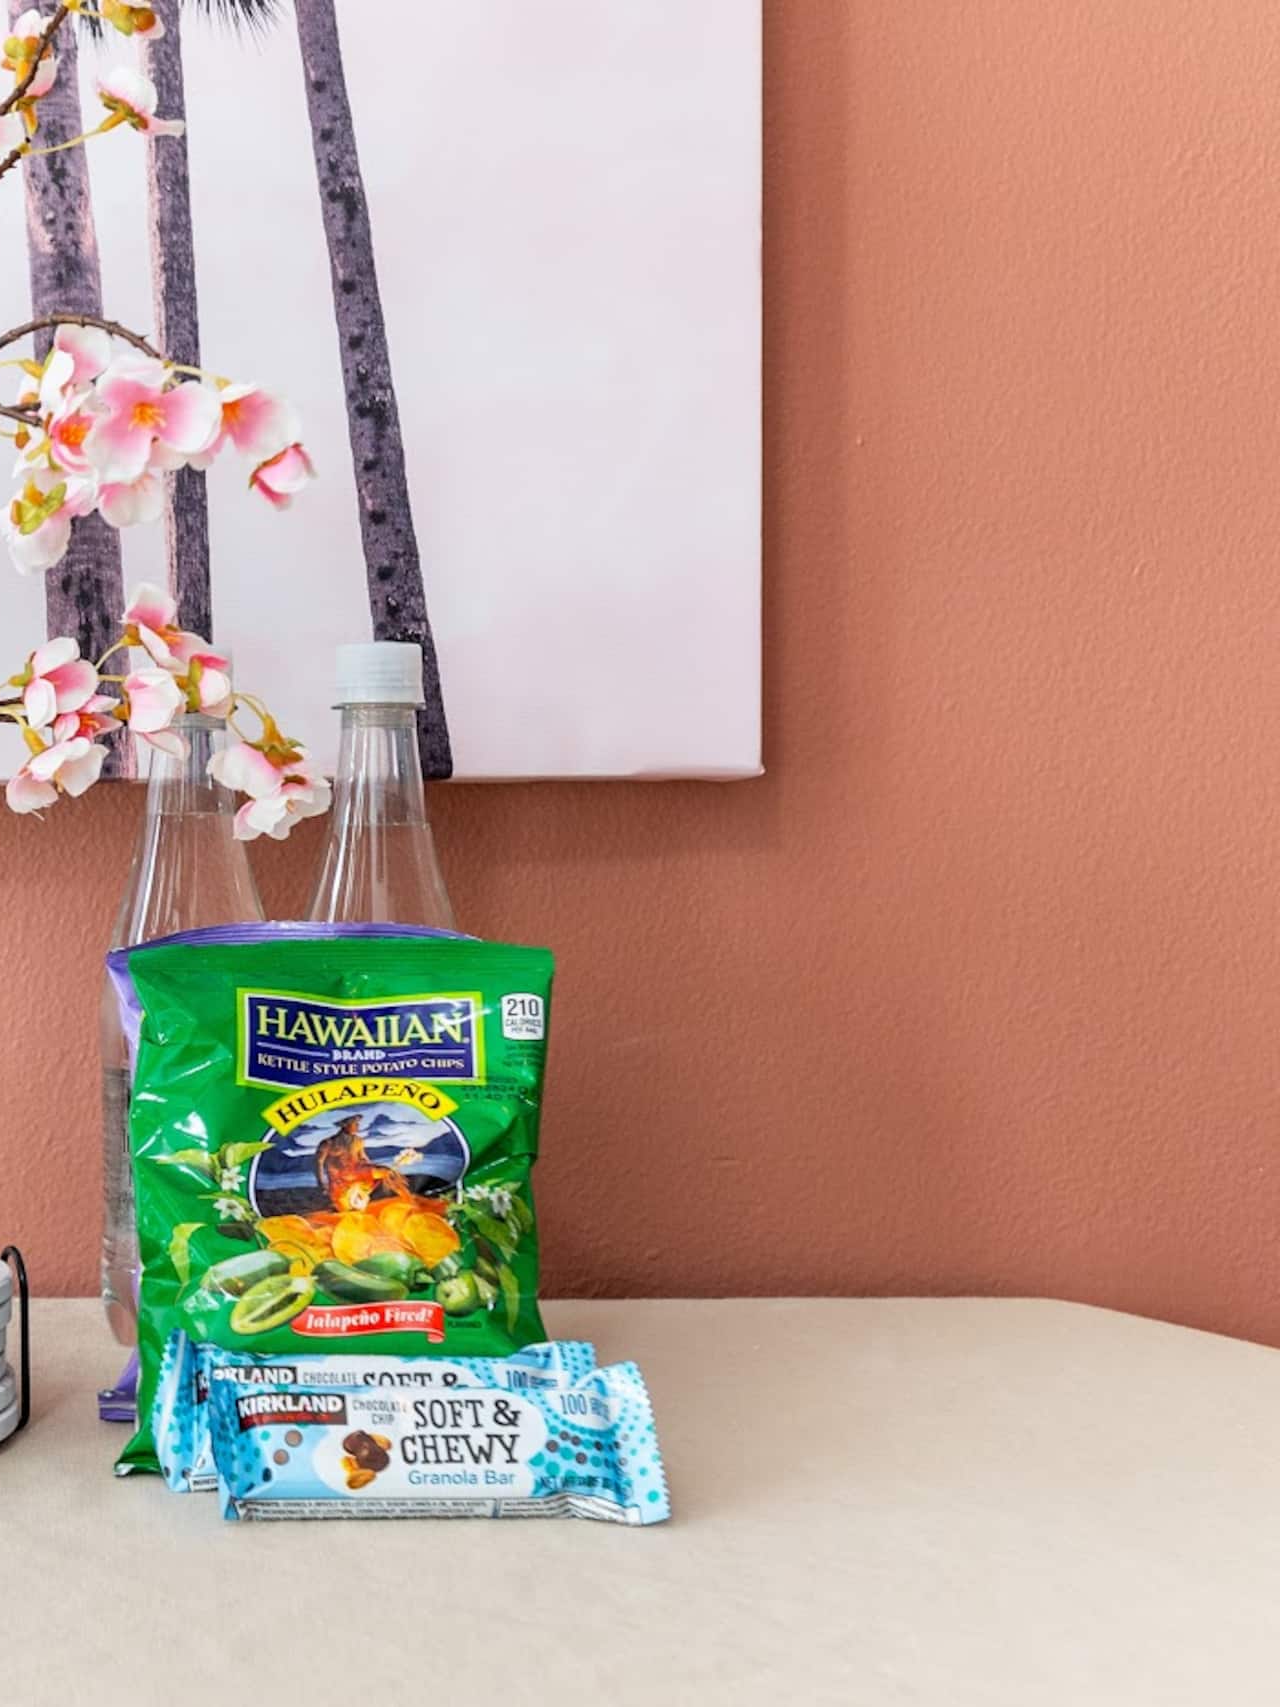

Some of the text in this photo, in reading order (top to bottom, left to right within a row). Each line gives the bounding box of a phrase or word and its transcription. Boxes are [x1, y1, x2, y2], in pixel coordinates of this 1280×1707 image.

[507, 998, 539, 1016] 210
[256, 1005, 464, 1048] HAWAIIAN
[257, 1053, 464, 1075] KETTLE STYLE POTATO CHIPS
[332, 1050, 386, 1061] BRAND
[275, 1081, 441, 1125] HULAPEÑO
[303, 1372, 357, 1384] CHOCOLATE
[238, 1394, 343, 1418] KIRKLAND
[413, 1399, 521, 1429] SOFT &
[560, 1393, 588, 1415] 100
[372, 1414, 395, 1425] CHIP
[400, 1434, 520, 1465] CHEWY
[408, 1470, 515, 1485] Granola Bar
